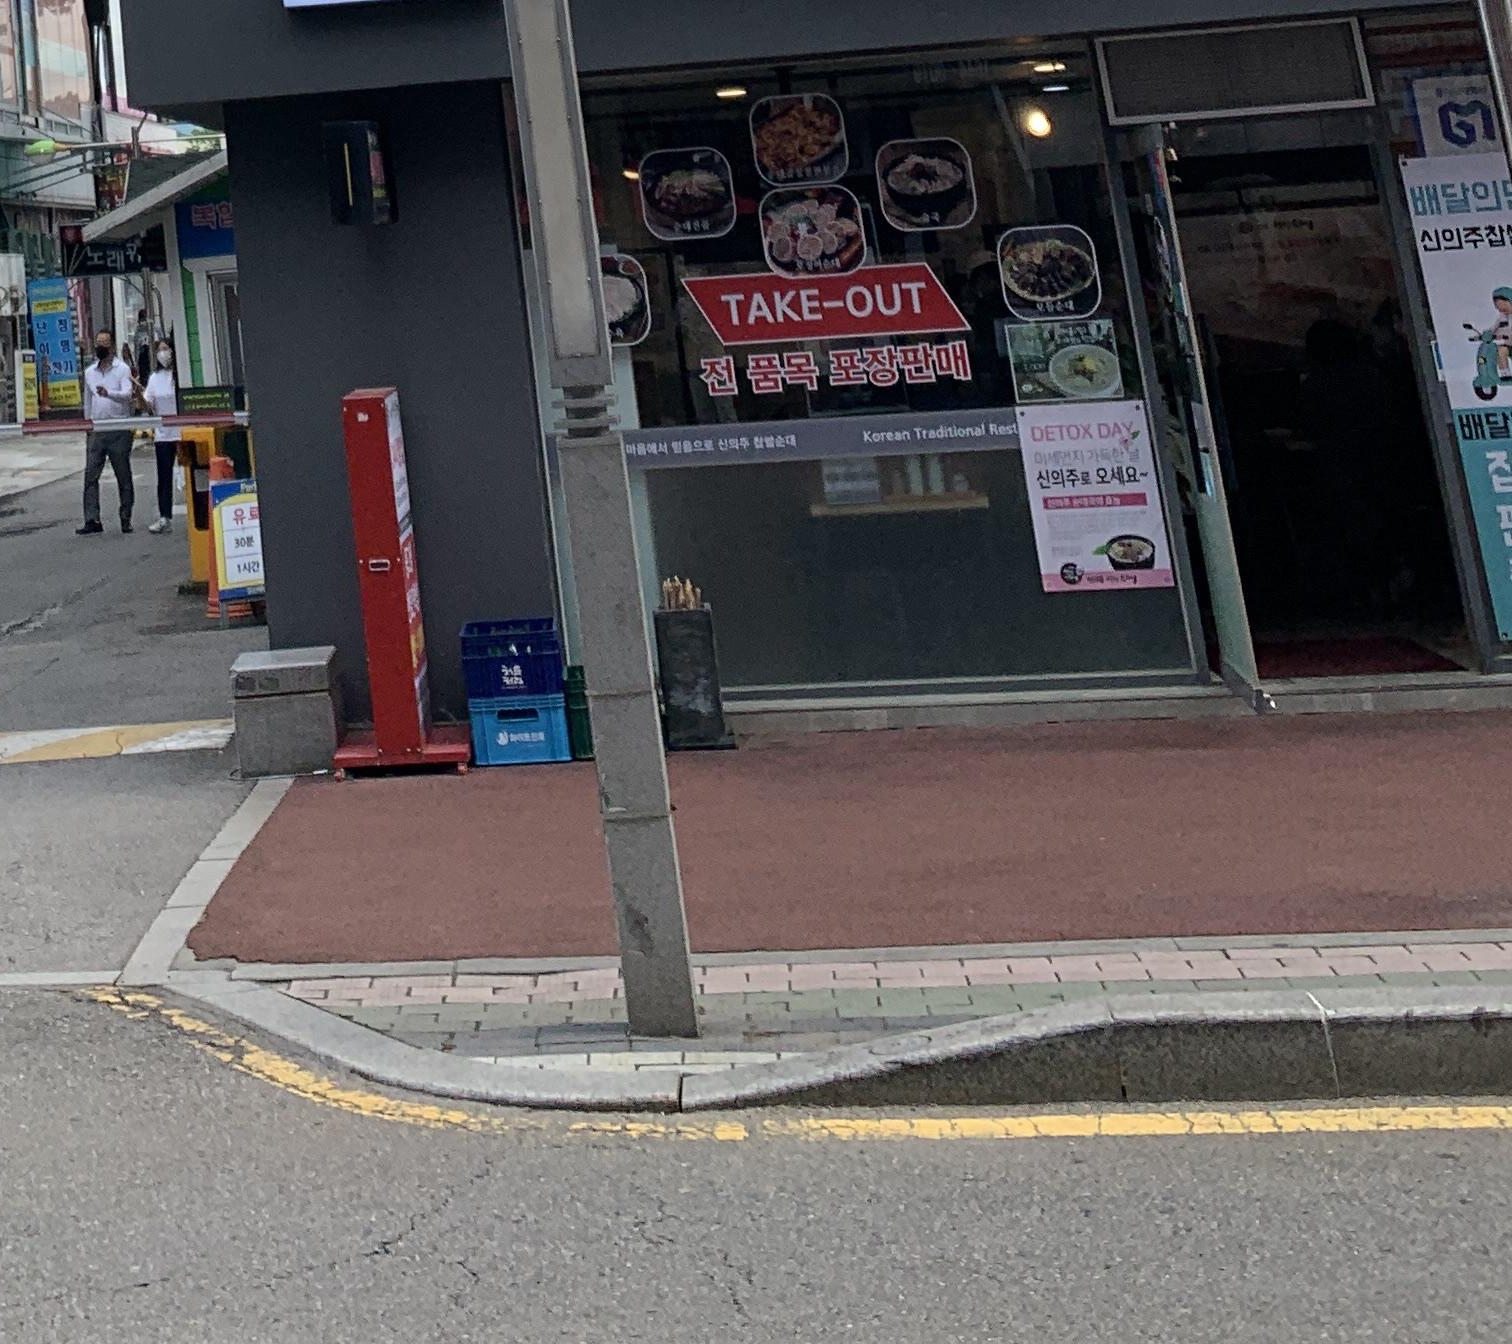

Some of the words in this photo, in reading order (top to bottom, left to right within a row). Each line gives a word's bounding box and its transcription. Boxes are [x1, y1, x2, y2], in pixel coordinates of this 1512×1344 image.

[1420, 223, 1512, 253] 신의주찹
[720, 279, 928, 329] TAKE-OUT
[699, 356, 737, 397] 전
[746, 350, 821, 395] 품목
[828, 338, 973, 388] 포장판매
[862, 426, 912, 443] Korean
[914, 423, 987, 441] Traditional
[1031, 423, 1094, 443] DETOX
[1096, 420, 1135, 440] DAY
[1037, 468, 1093, 490] 신의주로
